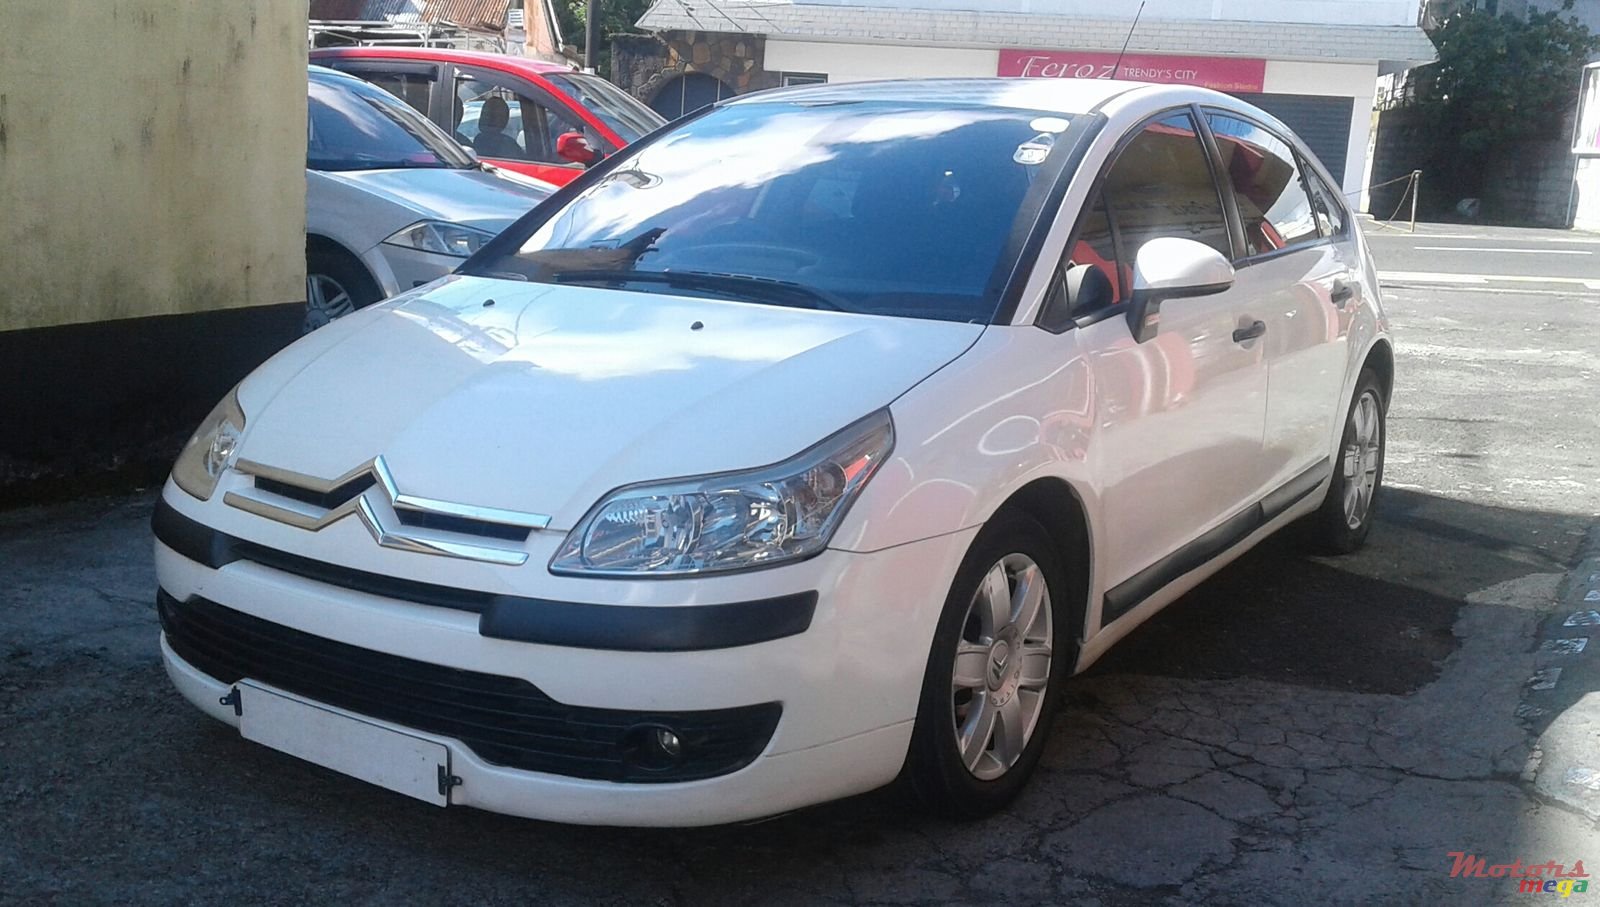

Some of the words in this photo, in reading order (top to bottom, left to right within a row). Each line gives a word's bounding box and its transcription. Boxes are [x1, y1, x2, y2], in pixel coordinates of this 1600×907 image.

[1017, 55, 1116, 79] Feroz
[1123, 67, 1172, 79] TRENDY'S
[1174, 69, 1198, 80] CITY
